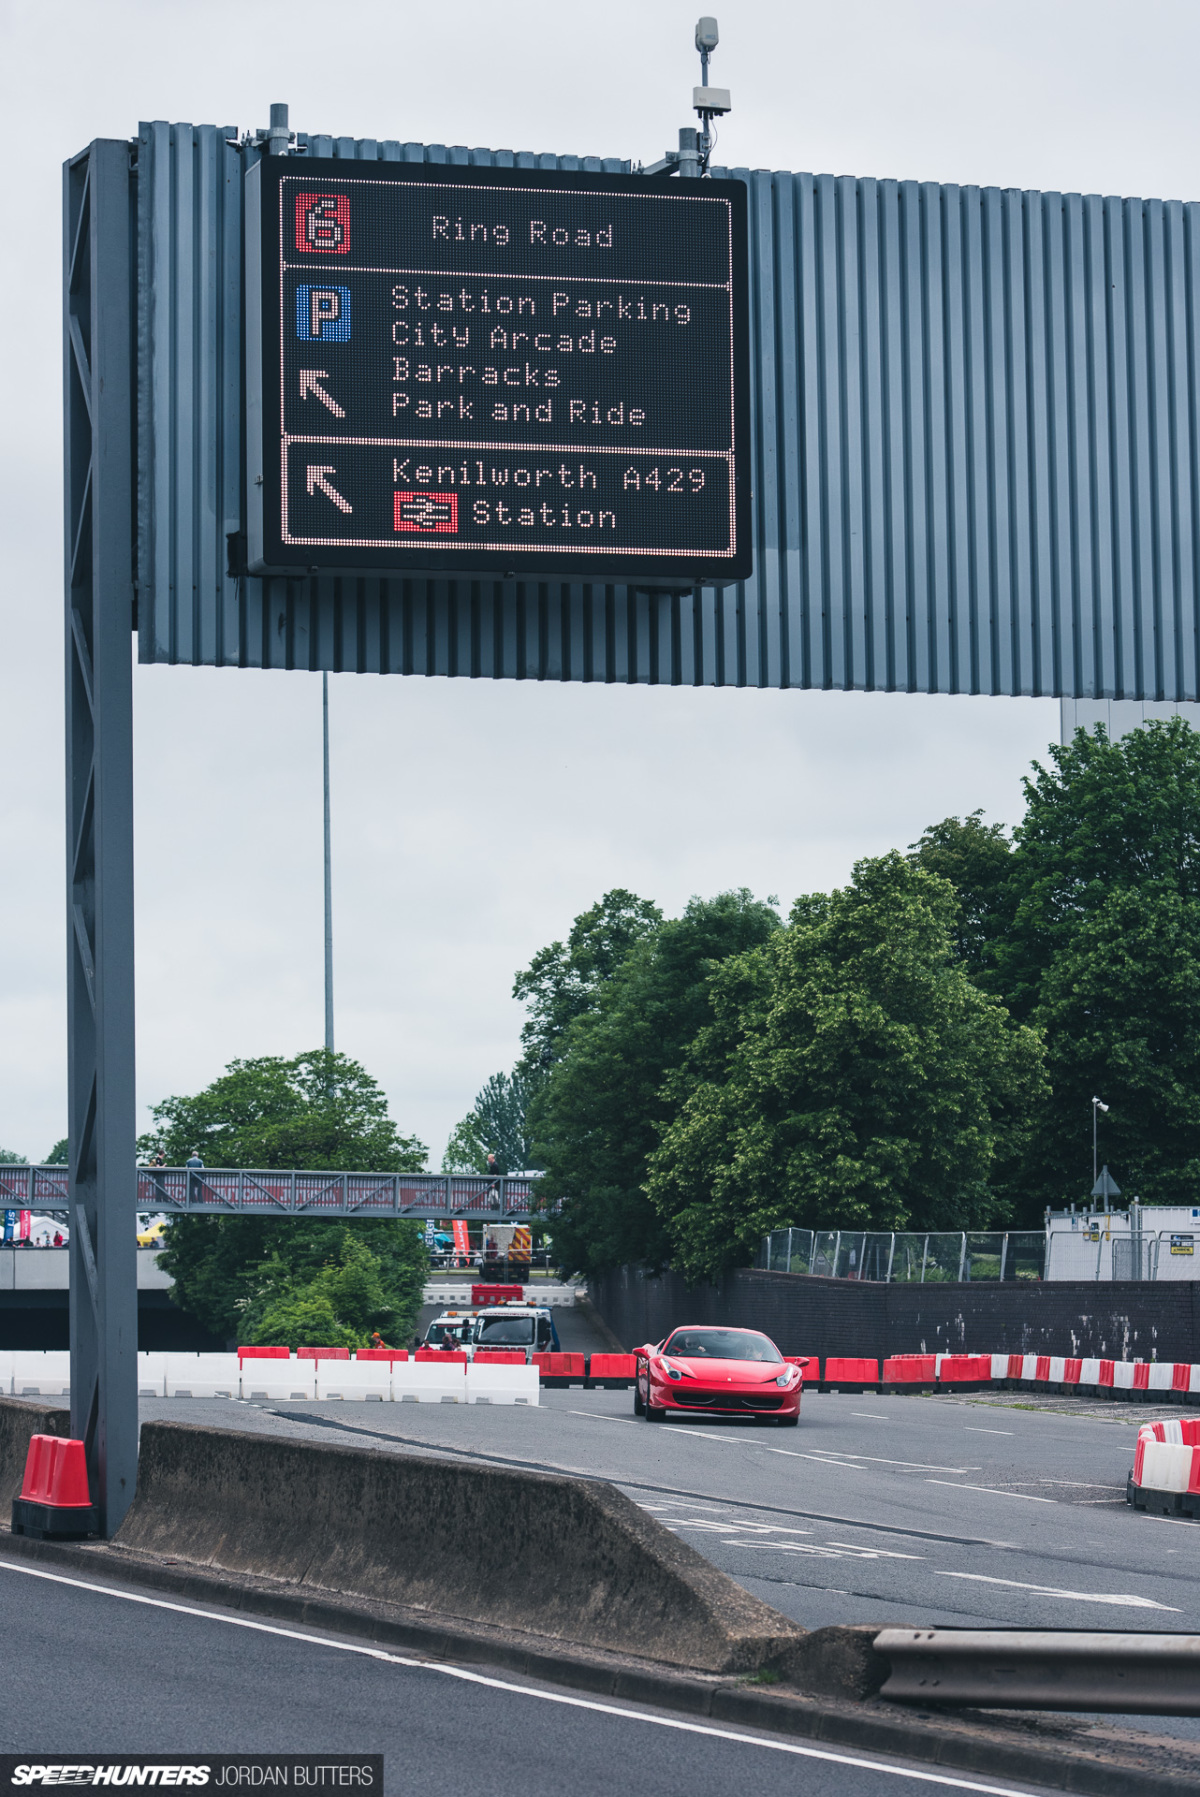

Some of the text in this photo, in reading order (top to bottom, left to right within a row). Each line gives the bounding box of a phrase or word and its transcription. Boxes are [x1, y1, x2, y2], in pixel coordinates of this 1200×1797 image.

[307, 201, 342, 249] 6
[433, 216, 612, 248] Ring Road
[313, 291, 339, 335] P
[393, 286, 691, 325] Station Parking
[393, 322, 617, 354] City Arcade
[393, 357, 561, 387] Barracks
[393, 393, 645, 426] Park and Ride
[394, 459, 705, 492] Kenilworth A429
[474, 501, 616, 529] Station
